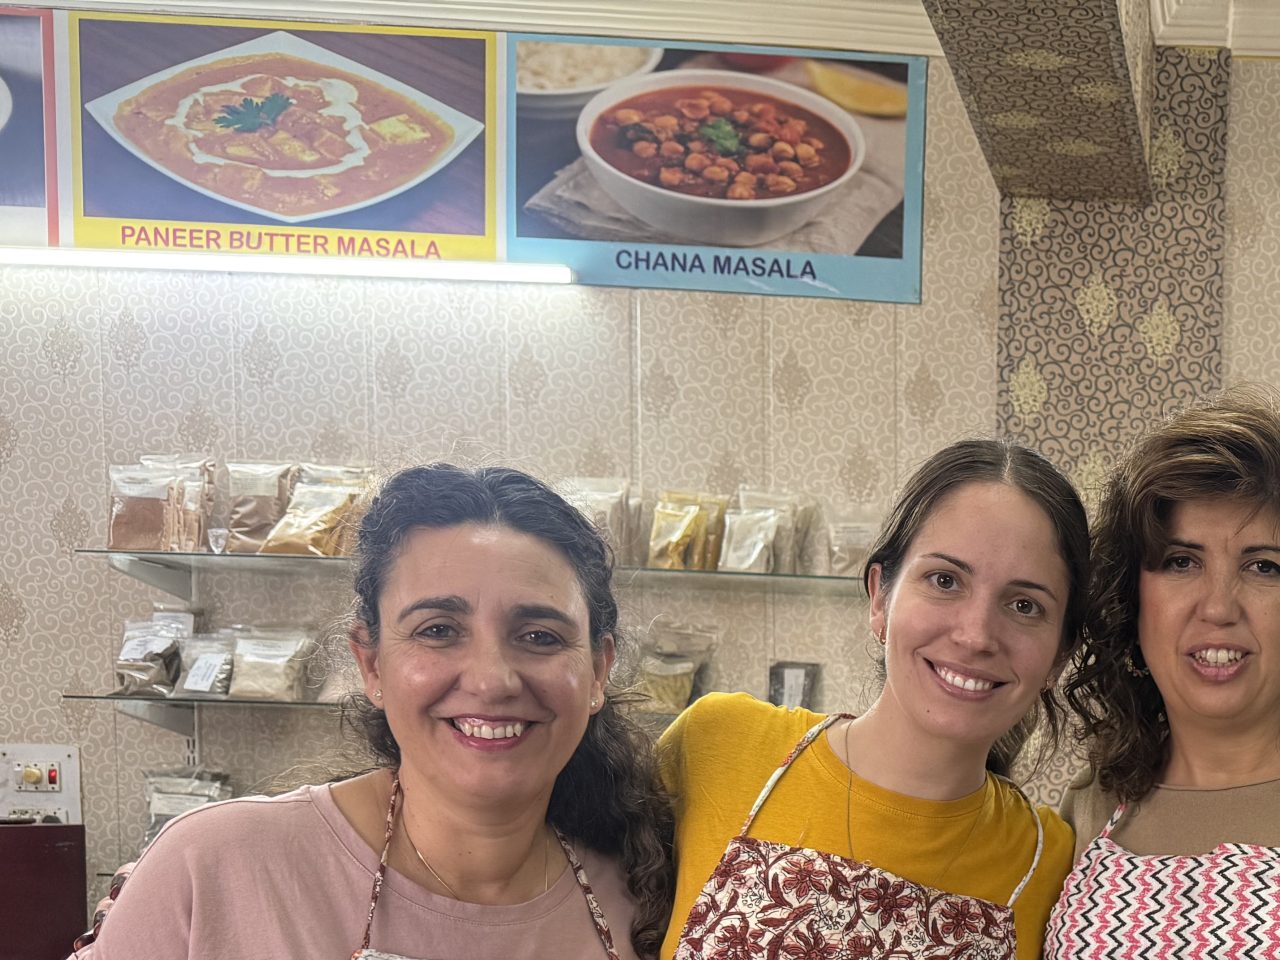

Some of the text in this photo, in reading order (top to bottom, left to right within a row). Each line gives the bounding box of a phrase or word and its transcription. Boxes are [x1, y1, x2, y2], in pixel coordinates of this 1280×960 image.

[121, 226, 441, 259] PANEER BUTTER MASALA
[616, 250, 817, 280] CHANA MASALA
